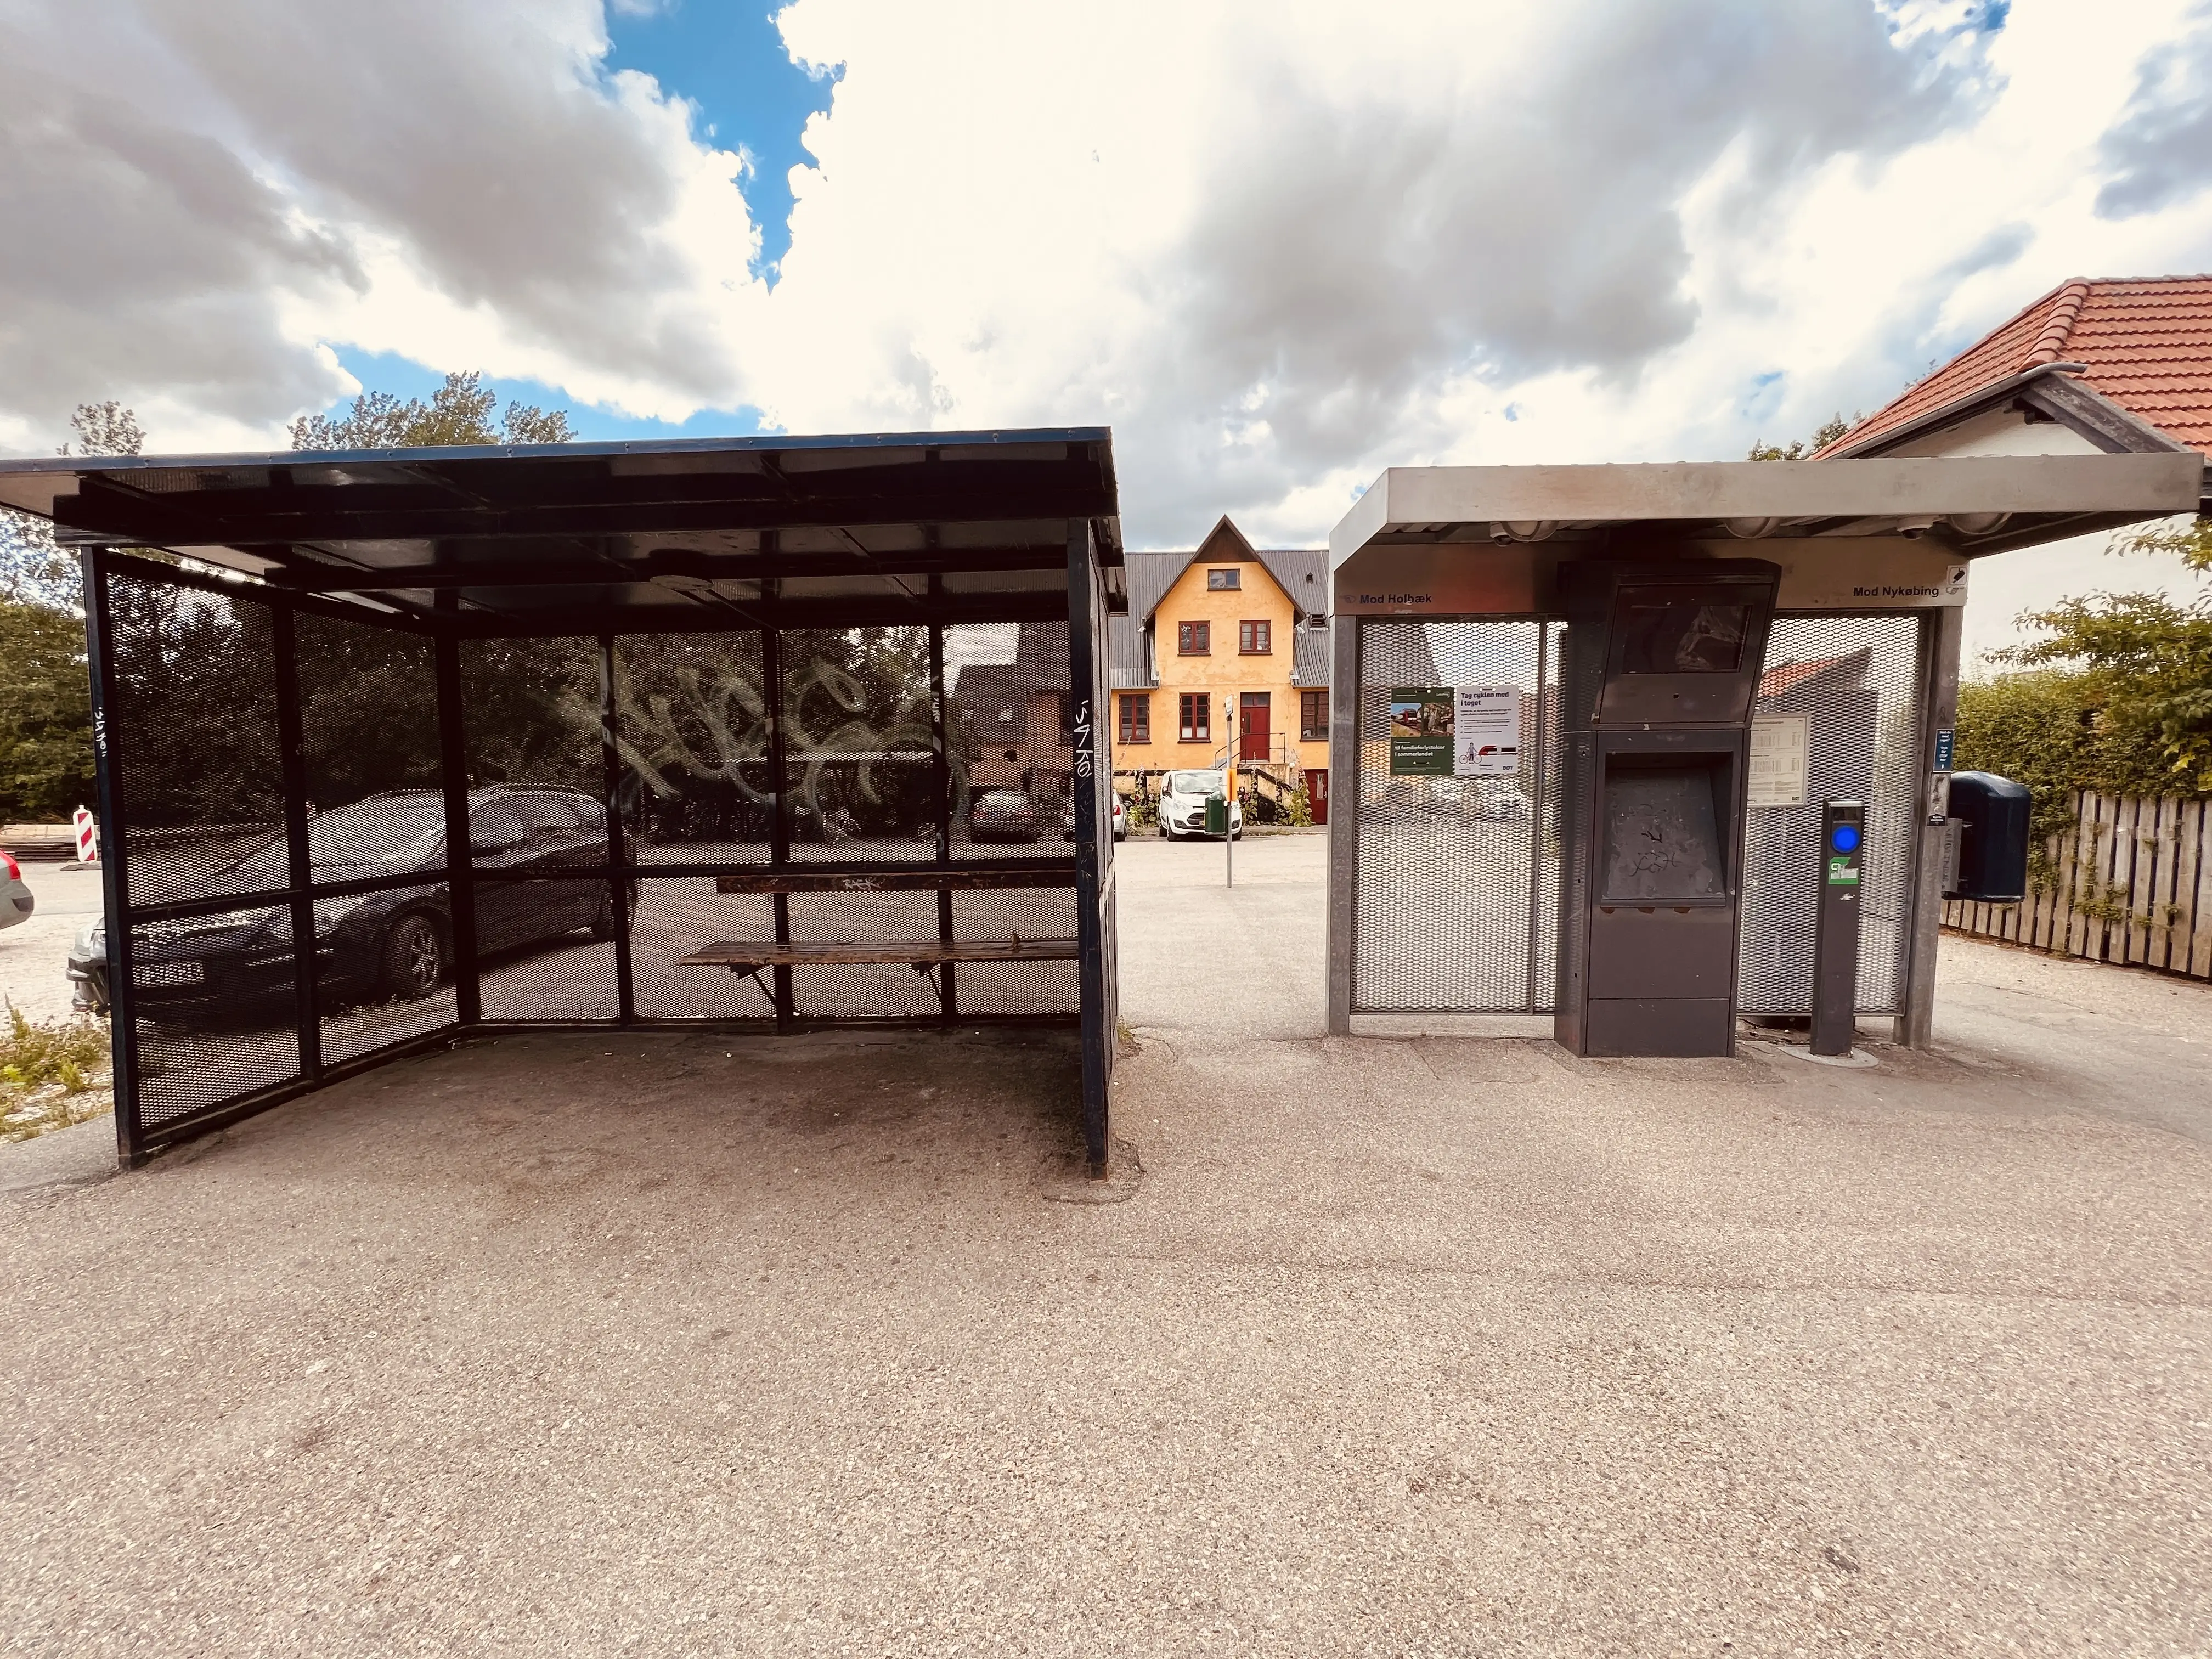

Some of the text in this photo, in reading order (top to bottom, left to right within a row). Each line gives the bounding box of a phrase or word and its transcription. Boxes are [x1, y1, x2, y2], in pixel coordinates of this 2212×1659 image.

[1853, 586, 1939, 598] Mod Nykøbing
[1360, 594, 1432, 603] Mod Holbæk
